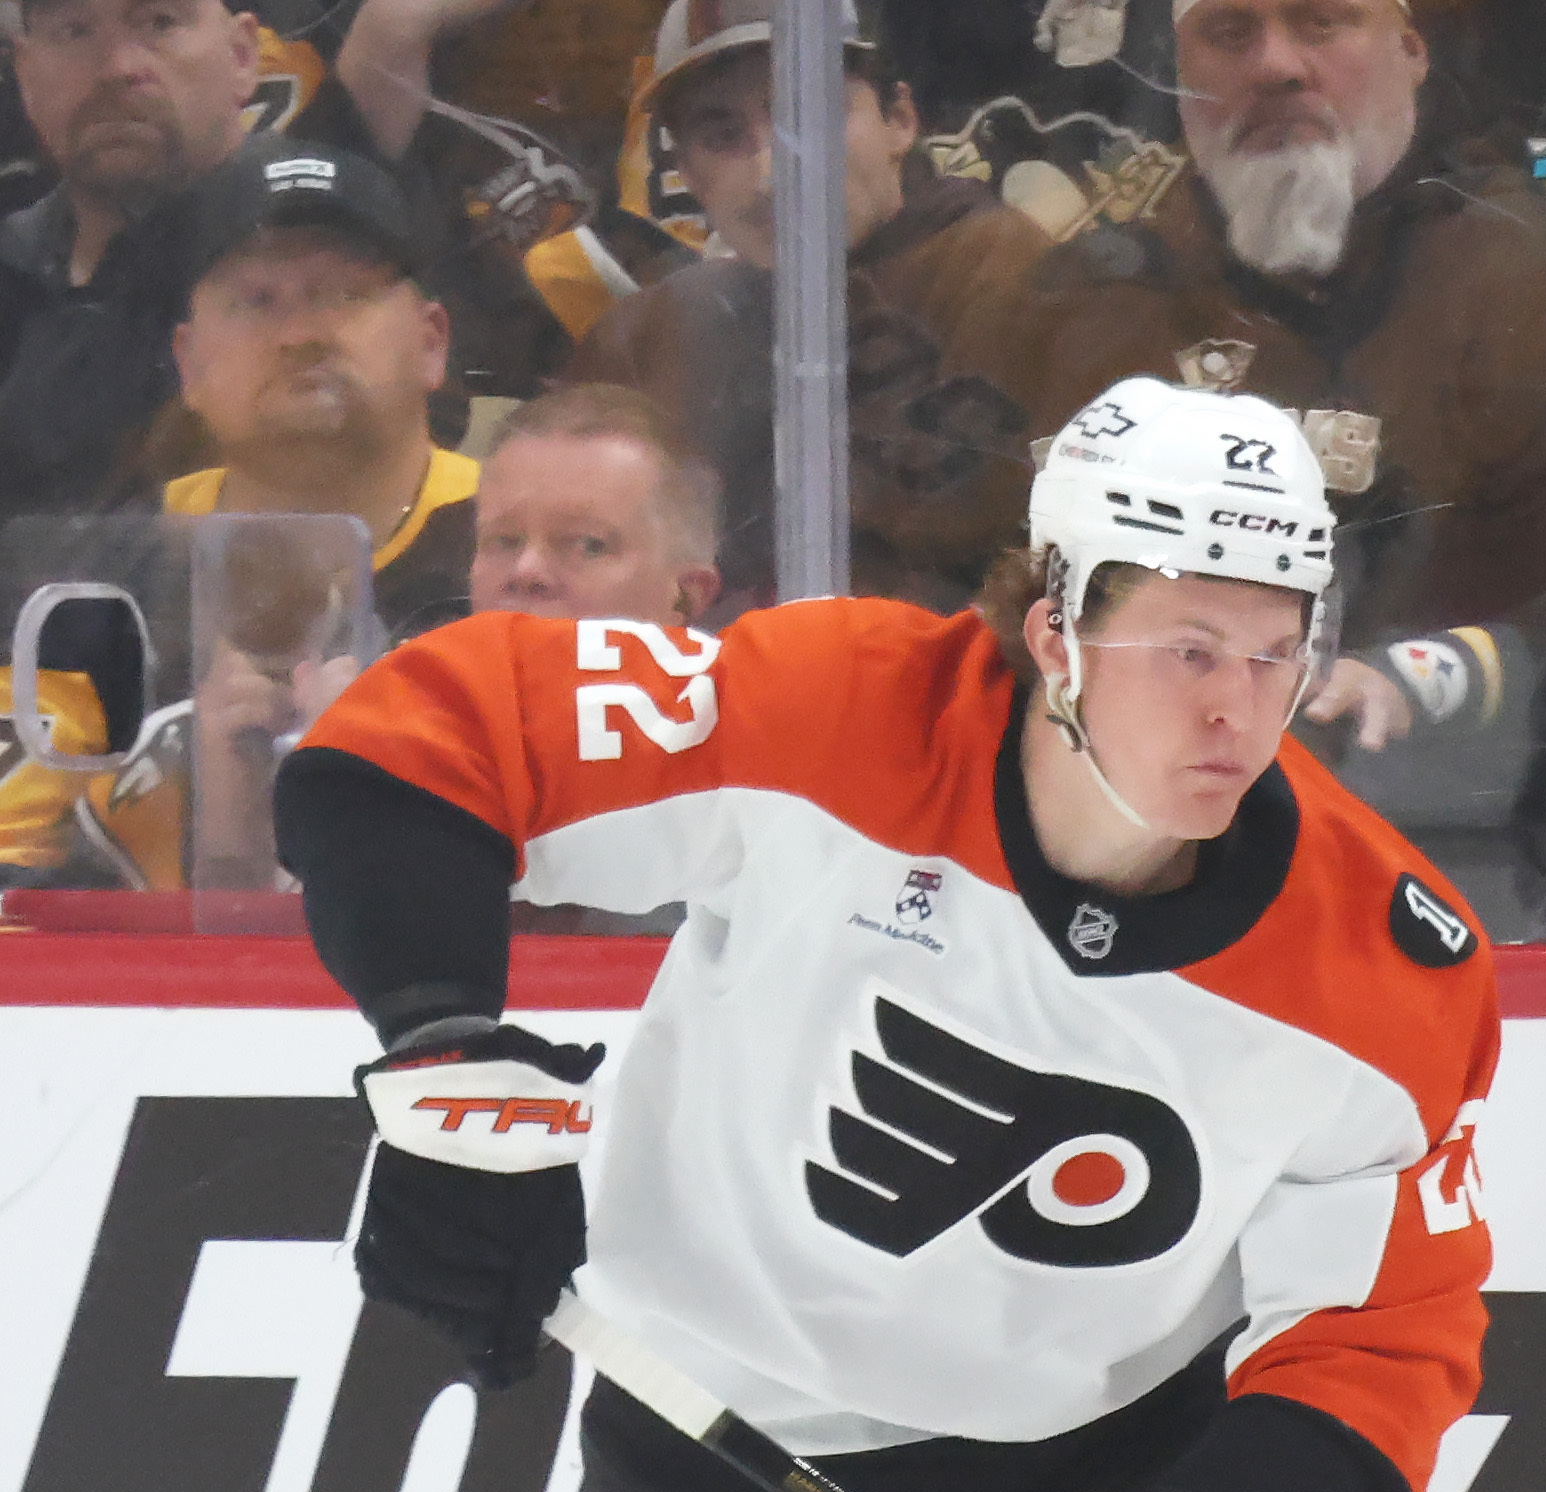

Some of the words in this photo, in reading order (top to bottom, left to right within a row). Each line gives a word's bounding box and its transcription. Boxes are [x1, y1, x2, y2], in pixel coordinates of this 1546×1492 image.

[1219, 433, 1282, 477] 22
[1209, 510, 1299, 538] CCM
[576, 617, 723, 762] 22
[1405, 881, 1469, 954] 1
